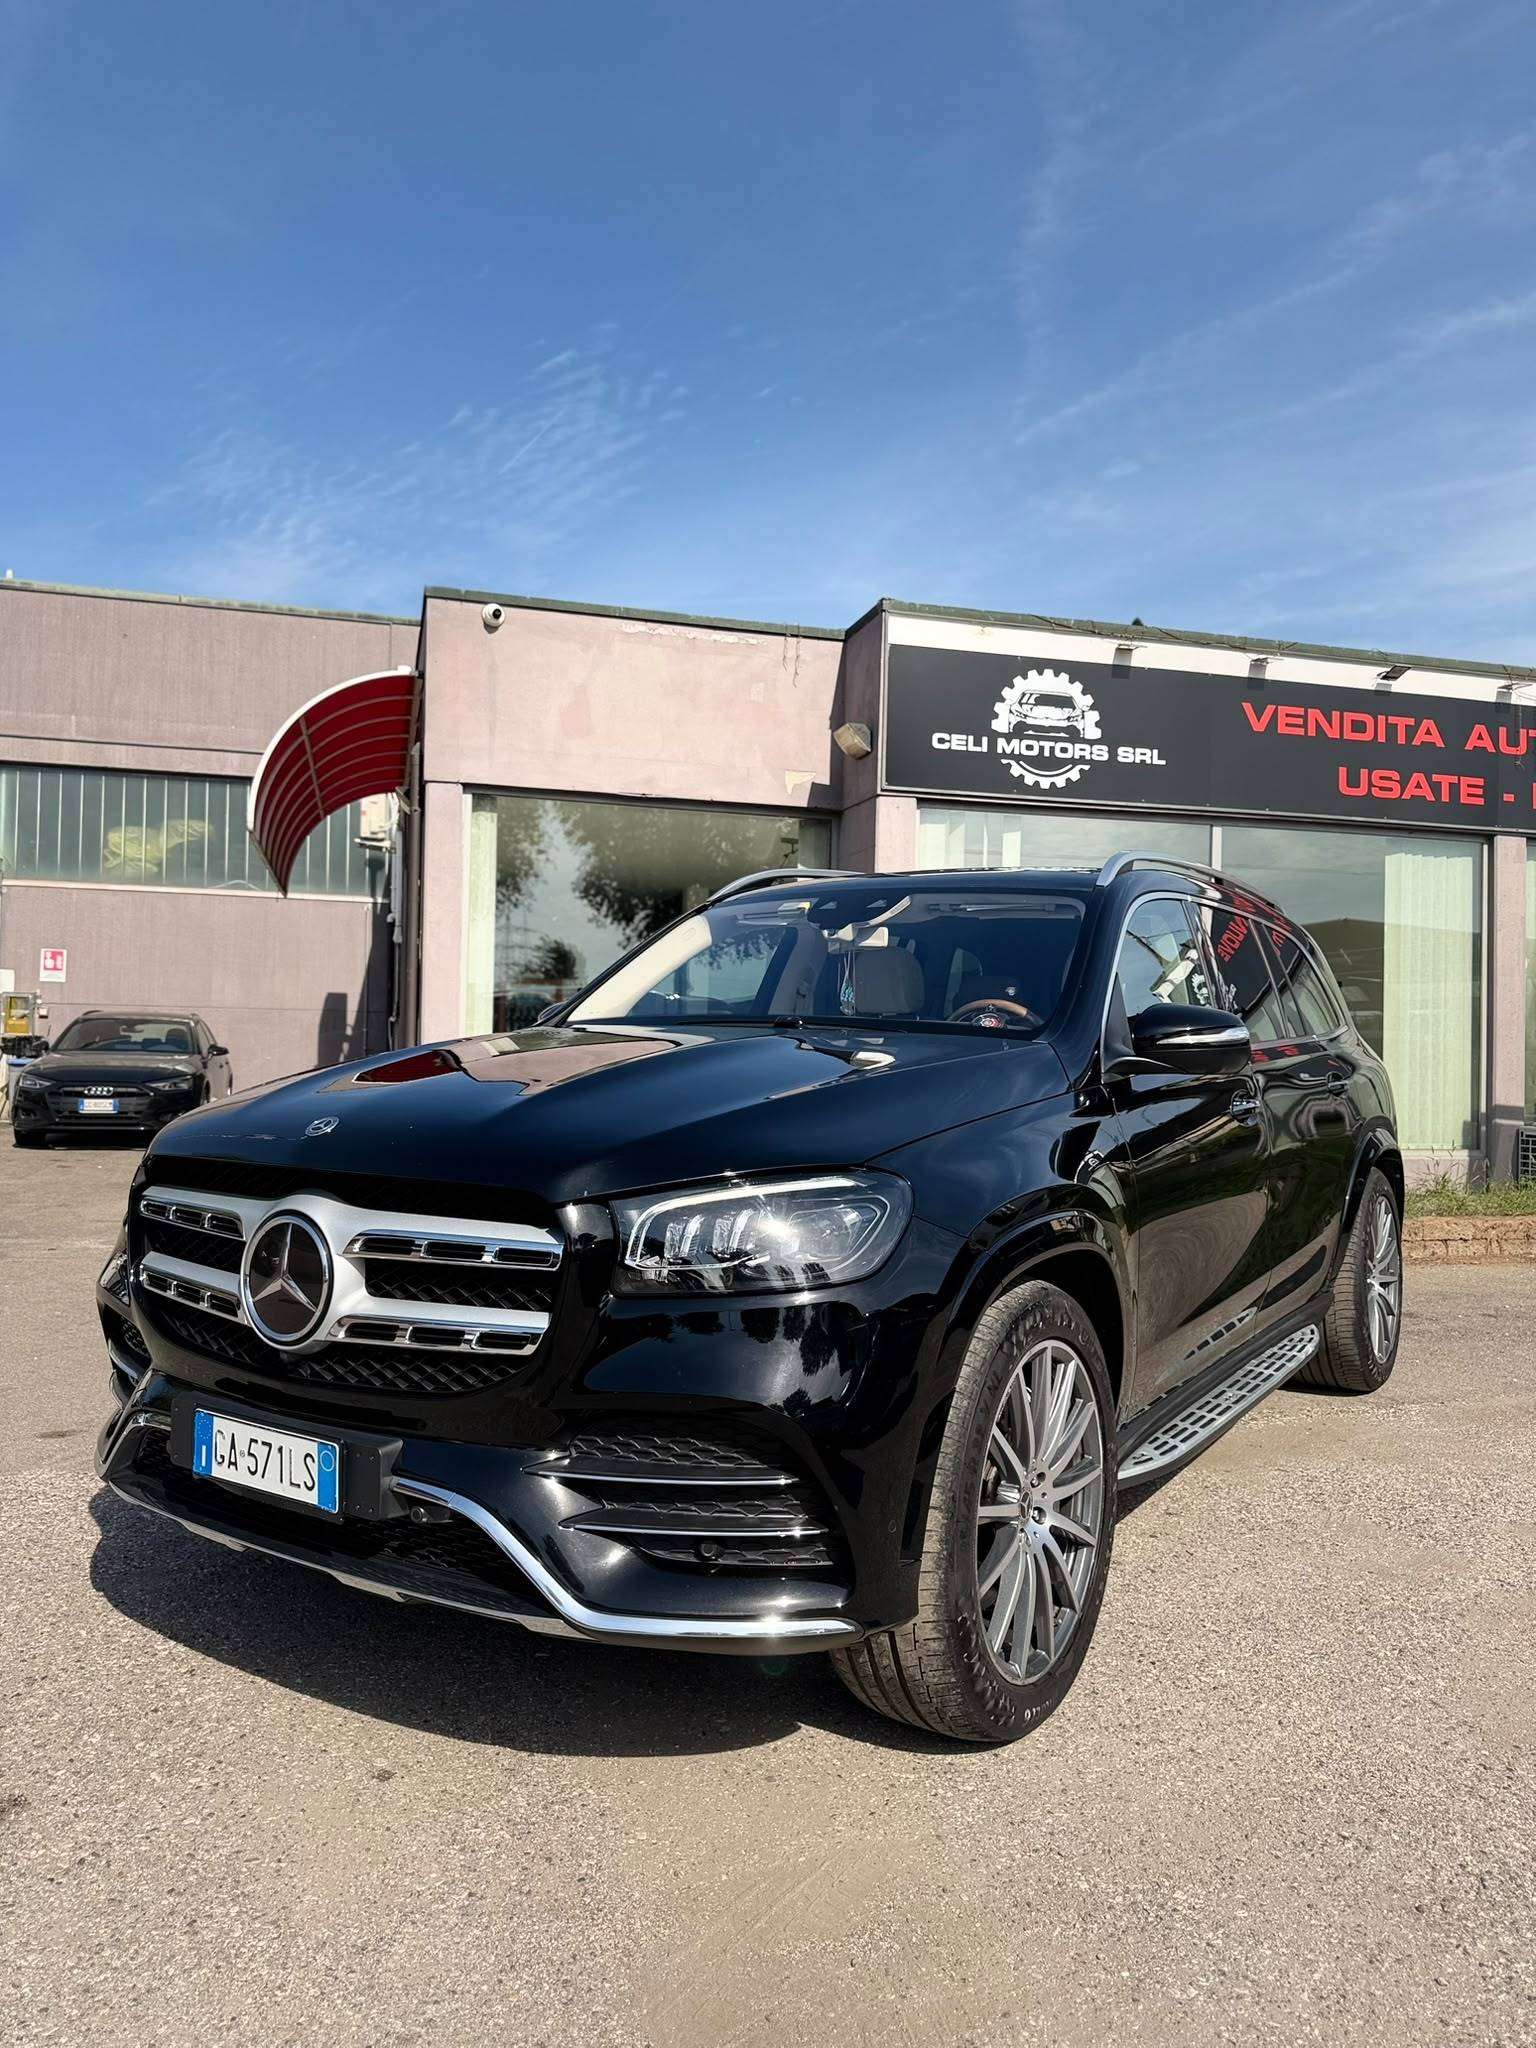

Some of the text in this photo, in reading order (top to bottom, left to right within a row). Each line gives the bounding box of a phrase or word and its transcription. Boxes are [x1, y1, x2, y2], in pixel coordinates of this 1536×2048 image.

[1242, 702, 1446, 748] VENDITA
[931, 732, 1167, 766] CELI MOTORS SRL
[1338, 766, 1486, 806] USATE
